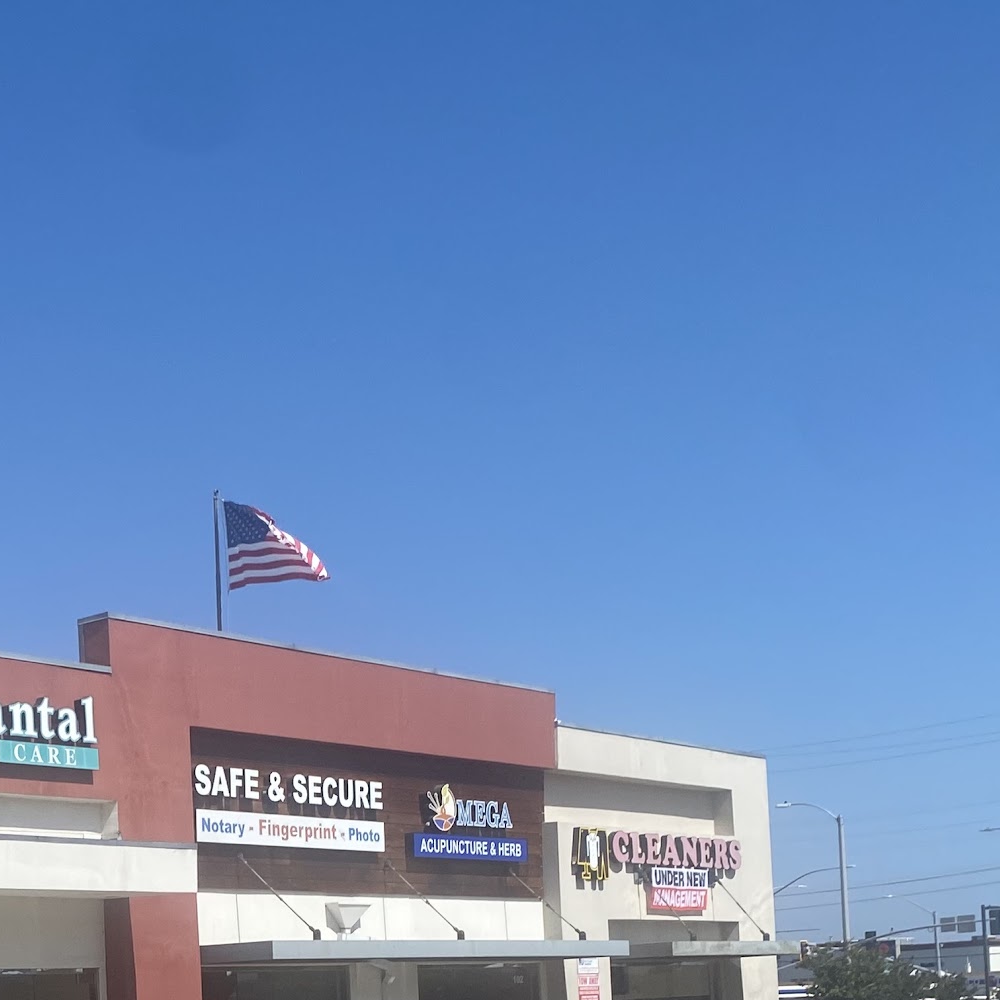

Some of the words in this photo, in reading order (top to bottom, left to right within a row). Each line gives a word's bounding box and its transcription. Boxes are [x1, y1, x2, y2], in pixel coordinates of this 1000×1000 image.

[13, 743, 78, 766] CARE
[194, 763, 260, 800] SAFE
[267, 771, 286, 803] &
[292, 773, 384, 810] SECURE
[456, 799, 514, 829] MEGA
[201, 817, 246, 838] Notary
[258, 819, 337, 842] Fingerprint
[348, 827, 381, 842] Photo
[420, 838, 489, 855] ACUPUNCTURE
[490, 842, 497, 856] &
[498, 842, 522, 857] HERB
[611, 830, 742, 871] CLEANERS
[654, 869, 685, 887] UNDER
[686, 871, 706, 888] NEW
[652, 890, 707, 908] MANAGEMENT
